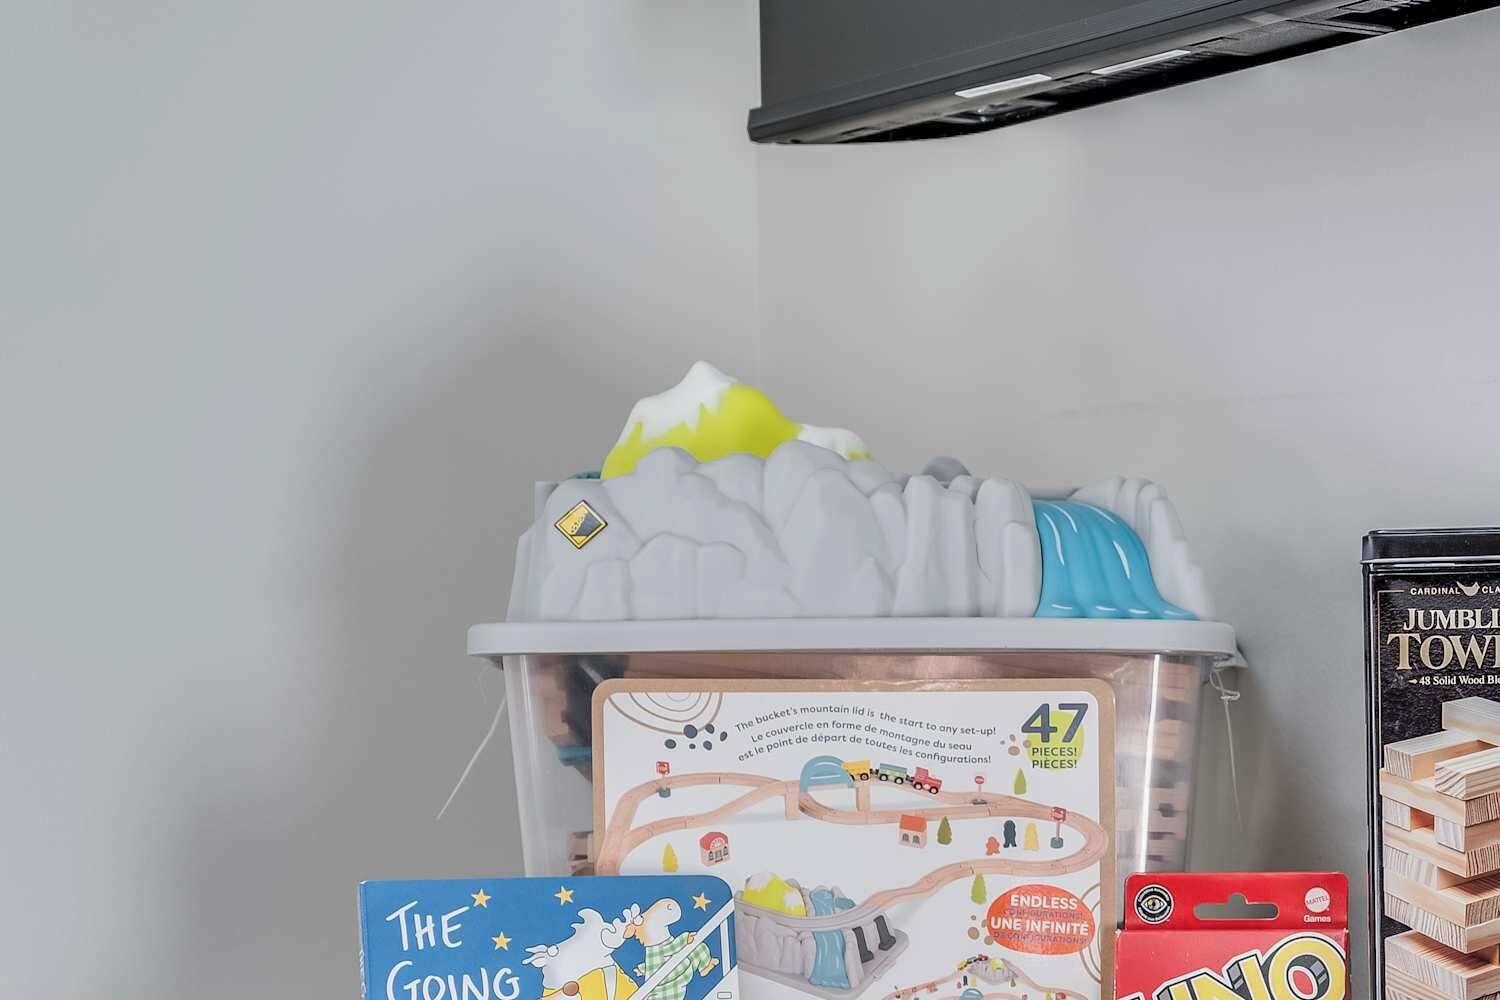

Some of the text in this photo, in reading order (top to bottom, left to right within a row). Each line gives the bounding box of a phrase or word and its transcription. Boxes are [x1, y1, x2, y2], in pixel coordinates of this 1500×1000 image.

[1410, 586, 1461, 596] CARDINAL
[1419, 675, 1431, 686] 48
[1433, 675, 1457, 686] Solid
[1459, 675, 1485, 686] Wood
[735, 705, 996, 737] The bucket's mountain lid is the start to any set-up!
[1021, 703, 1089, 743] 47
[751, 720, 972, 751] Le couvercle en forme de montagne du seau
[738, 733, 992, 765] est le point de départ de toutes les configurations!
[1032, 747, 1077, 757] PIECES!
[1010, 894, 1078, 910] ENDLESS
[386, 901, 470, 952] THE
[990, 916, 1089, 936] UNE INFINITÉ
[1303, 914, 1332, 923] Games
